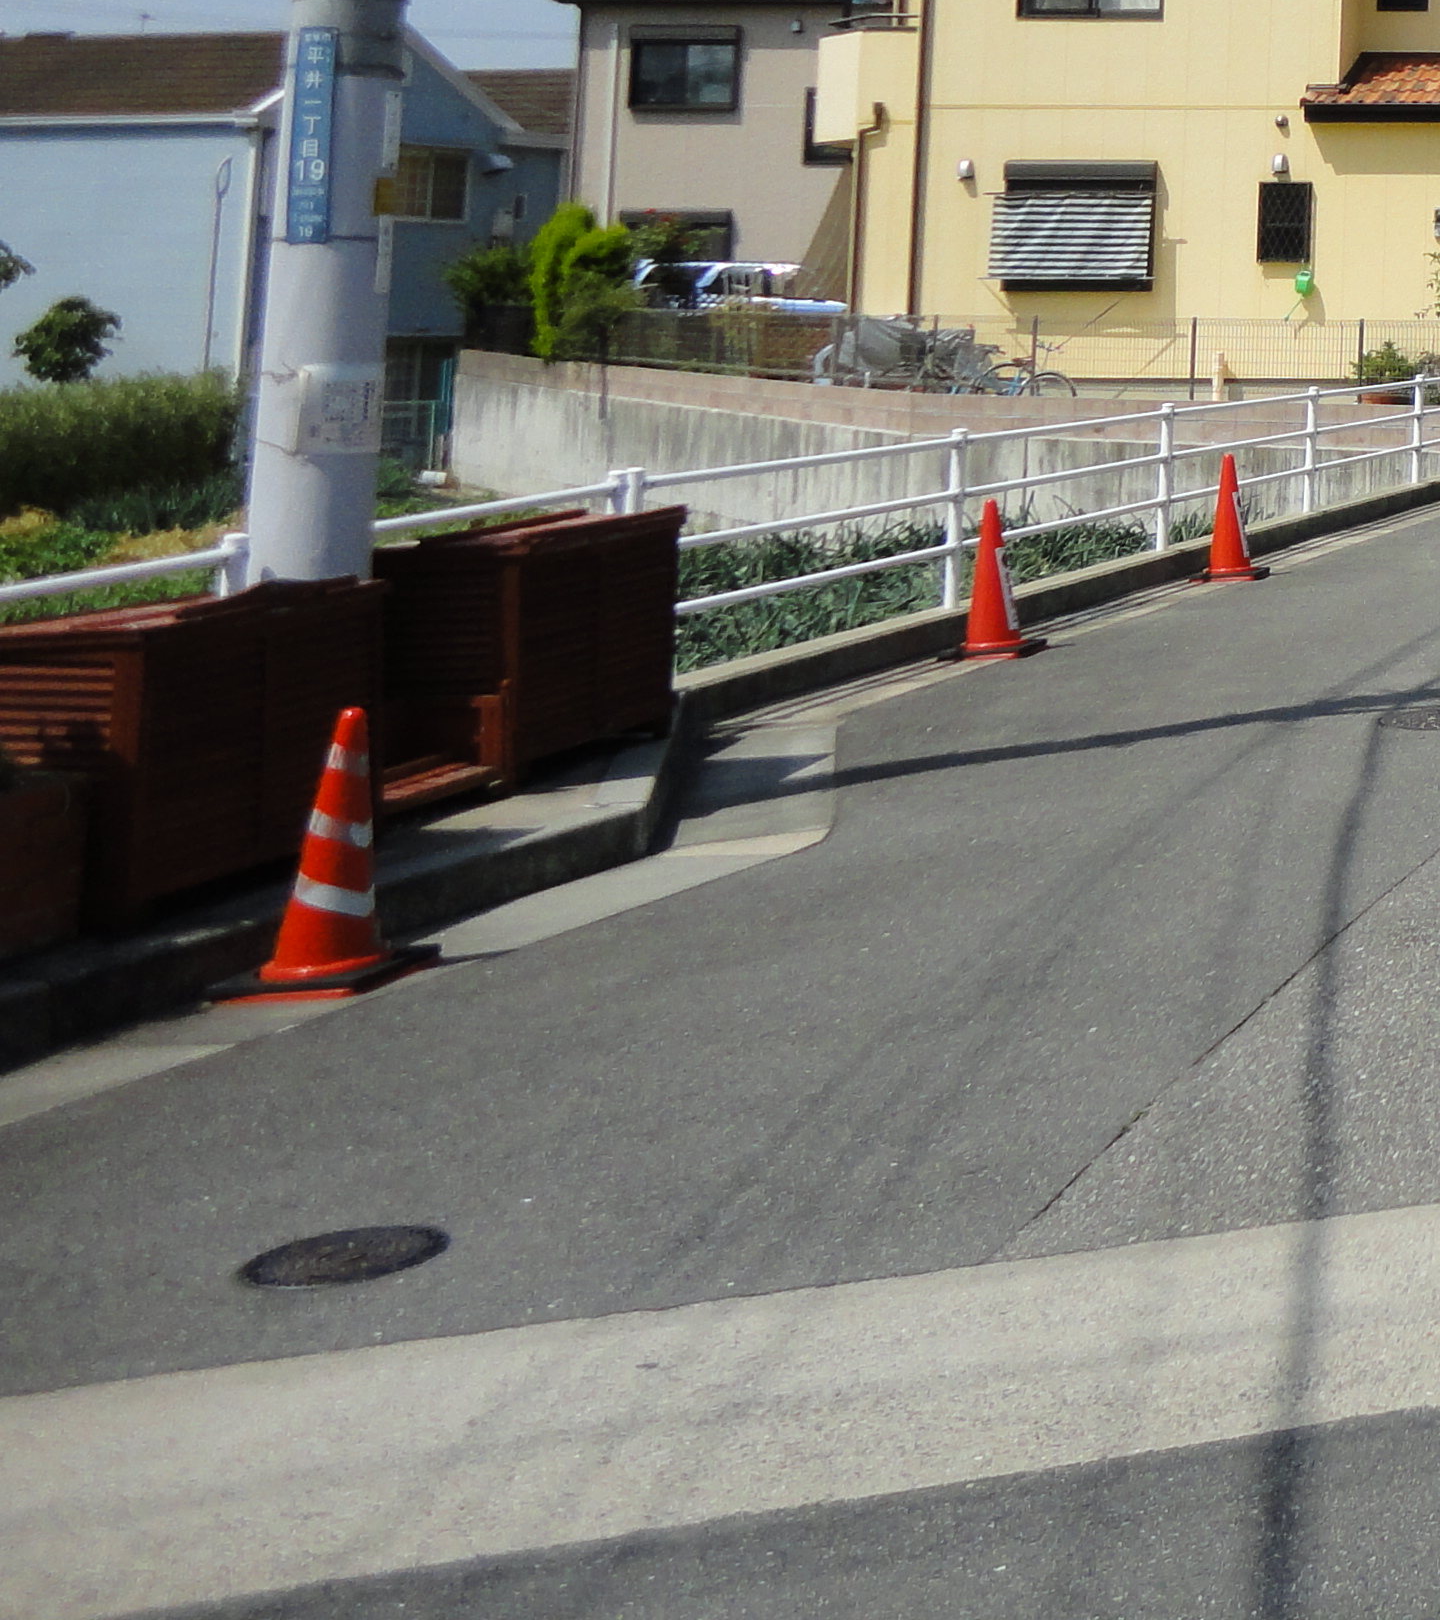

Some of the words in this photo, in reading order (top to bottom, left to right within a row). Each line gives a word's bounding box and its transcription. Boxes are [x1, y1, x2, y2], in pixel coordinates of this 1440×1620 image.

[302, 46, 325, 158] 平井一丁目
[294, 159, 325, 181] 19
